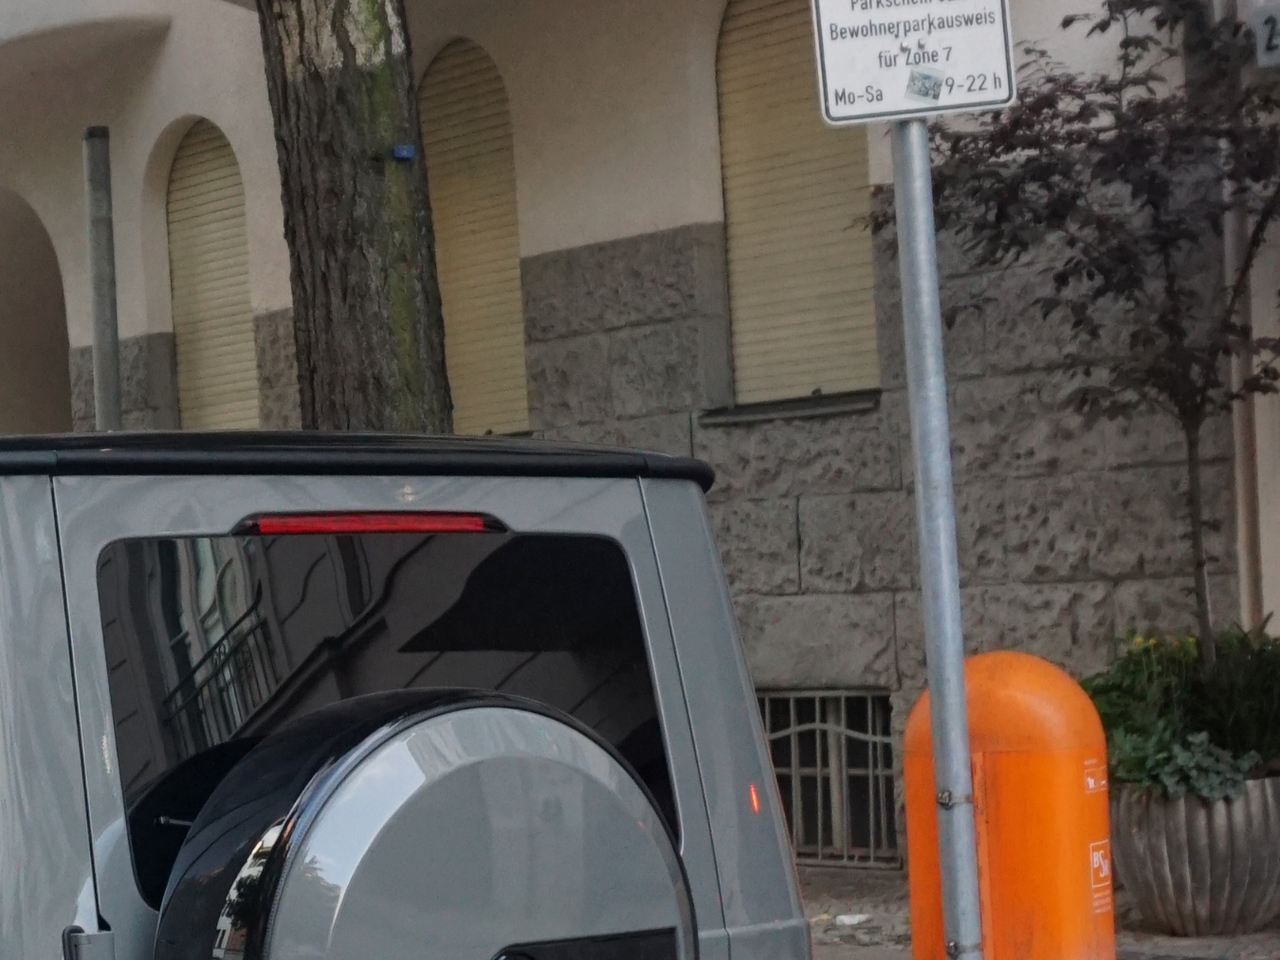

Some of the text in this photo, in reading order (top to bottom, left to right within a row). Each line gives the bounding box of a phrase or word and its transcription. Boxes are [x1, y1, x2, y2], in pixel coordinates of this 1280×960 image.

[830, 7, 996, 41] Bewohnerparkausweis
[878, 47, 952, 69] für Zone 7
[834, 86, 883, 106] Mo-Sa
[945, 73, 988, 94] 9-22
[993, 72, 1002, 90] h
